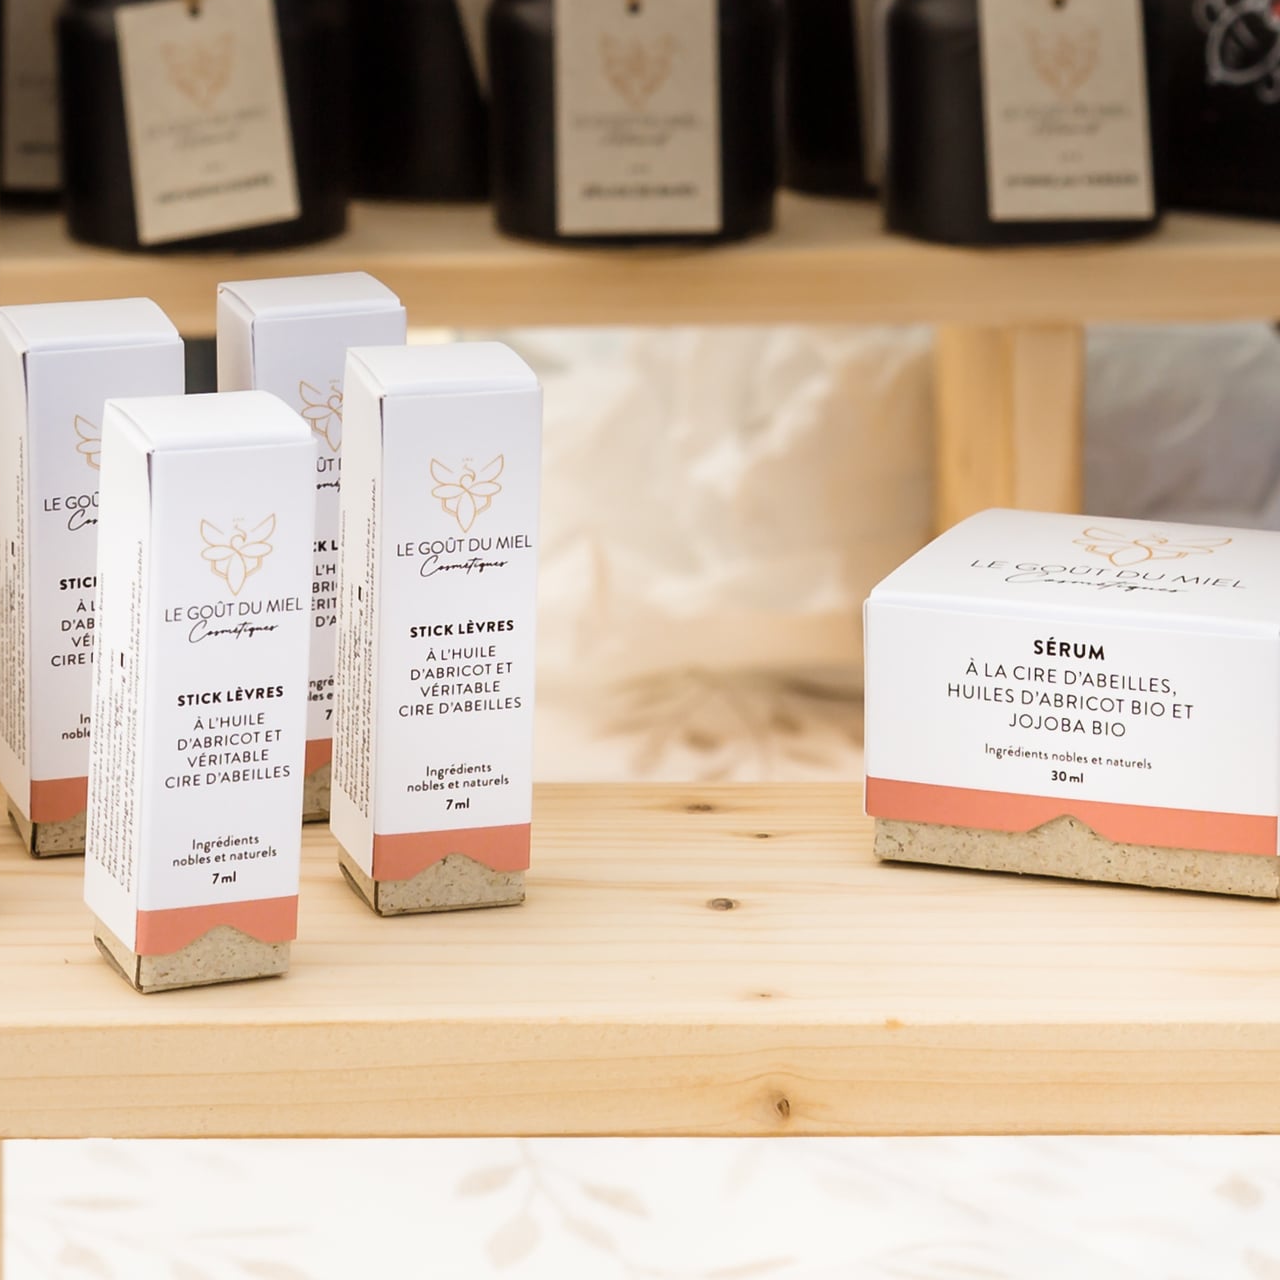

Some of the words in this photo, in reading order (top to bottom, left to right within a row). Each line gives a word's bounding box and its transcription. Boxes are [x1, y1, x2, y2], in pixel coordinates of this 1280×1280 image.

[164, 606, 183, 623] LE
[186, 601, 235, 622] GOÛT
[237, 599, 263, 616] DU
[265, 596, 303, 613] MIEL
[187, 620, 279, 644] Cosmétiques
[1033, 635, 1105, 661] SÉRUM
[177, 690, 222, 707] STICK
[226, 685, 284, 702] LÈVRES
[193, 715, 204, 731] À
[208, 711, 265, 730] L'HUILE
[176, 730, 261, 751] D'ABRICOT
[264, 728, 282, 743] ET
[186, 748, 269, 768] VÉRITABLE
[164, 773, 201, 789] CIRE
[205, 764, 291, 785] D'ABEILLES
[191, 834, 260, 854] Ingrédients
[172, 853, 211, 867] nobles
[213, 852, 226, 863] et
[229, 845, 277, 861] naturels
[211, 872, 220, 885] 7
[220, 870, 237, 884] ml
